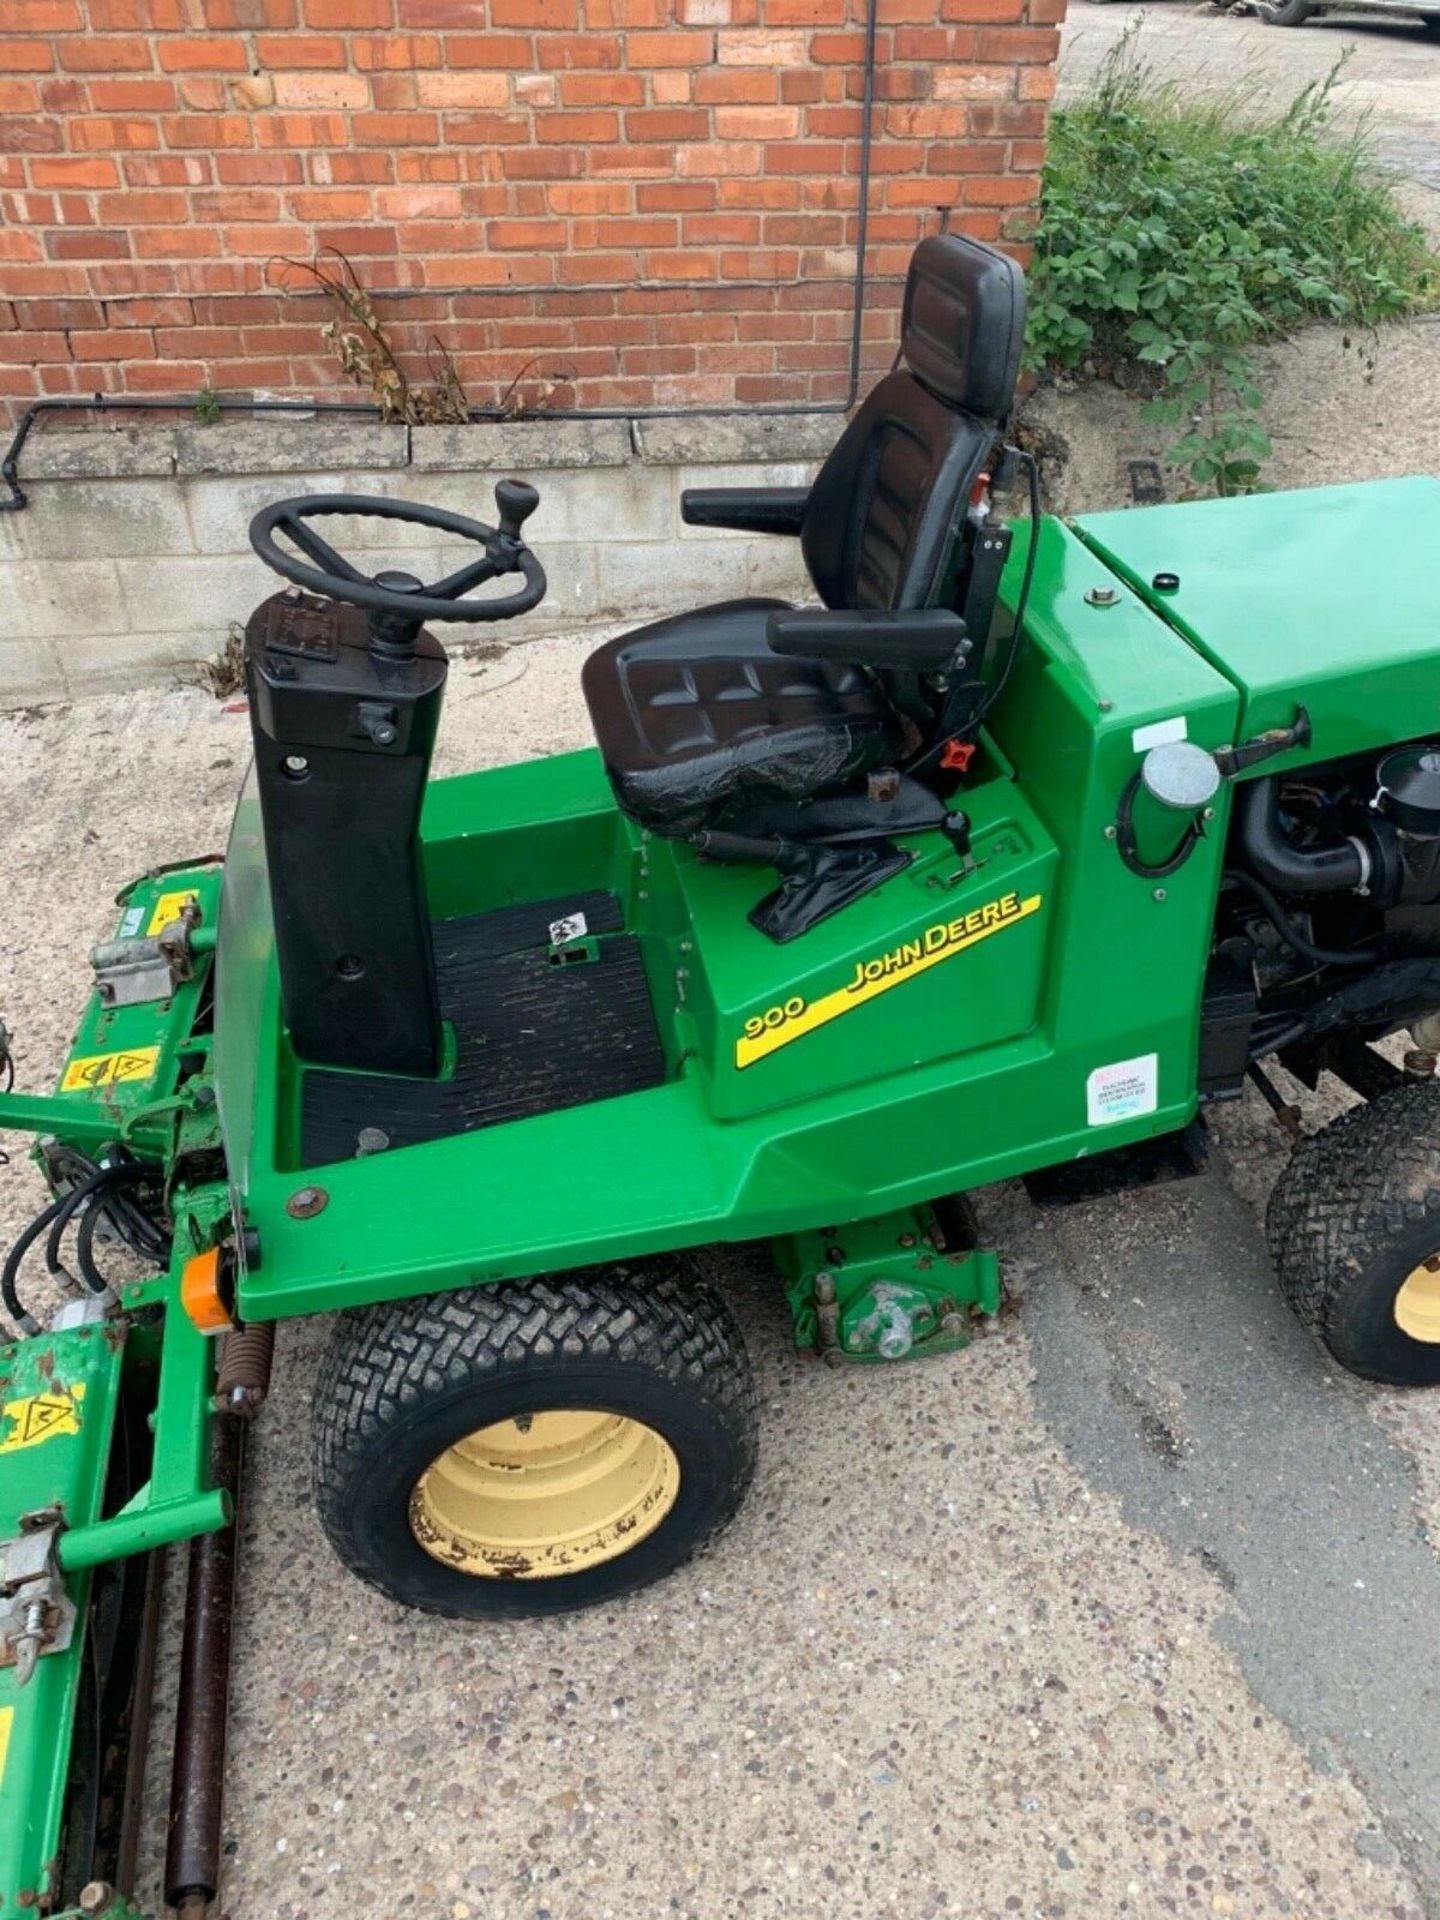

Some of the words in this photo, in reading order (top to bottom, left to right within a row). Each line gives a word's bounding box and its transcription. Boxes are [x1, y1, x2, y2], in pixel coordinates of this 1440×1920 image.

[744, 997, 808, 1040] 900
[847, 939, 924, 993] JOHN
[924, 892, 1022, 953] DEERE
